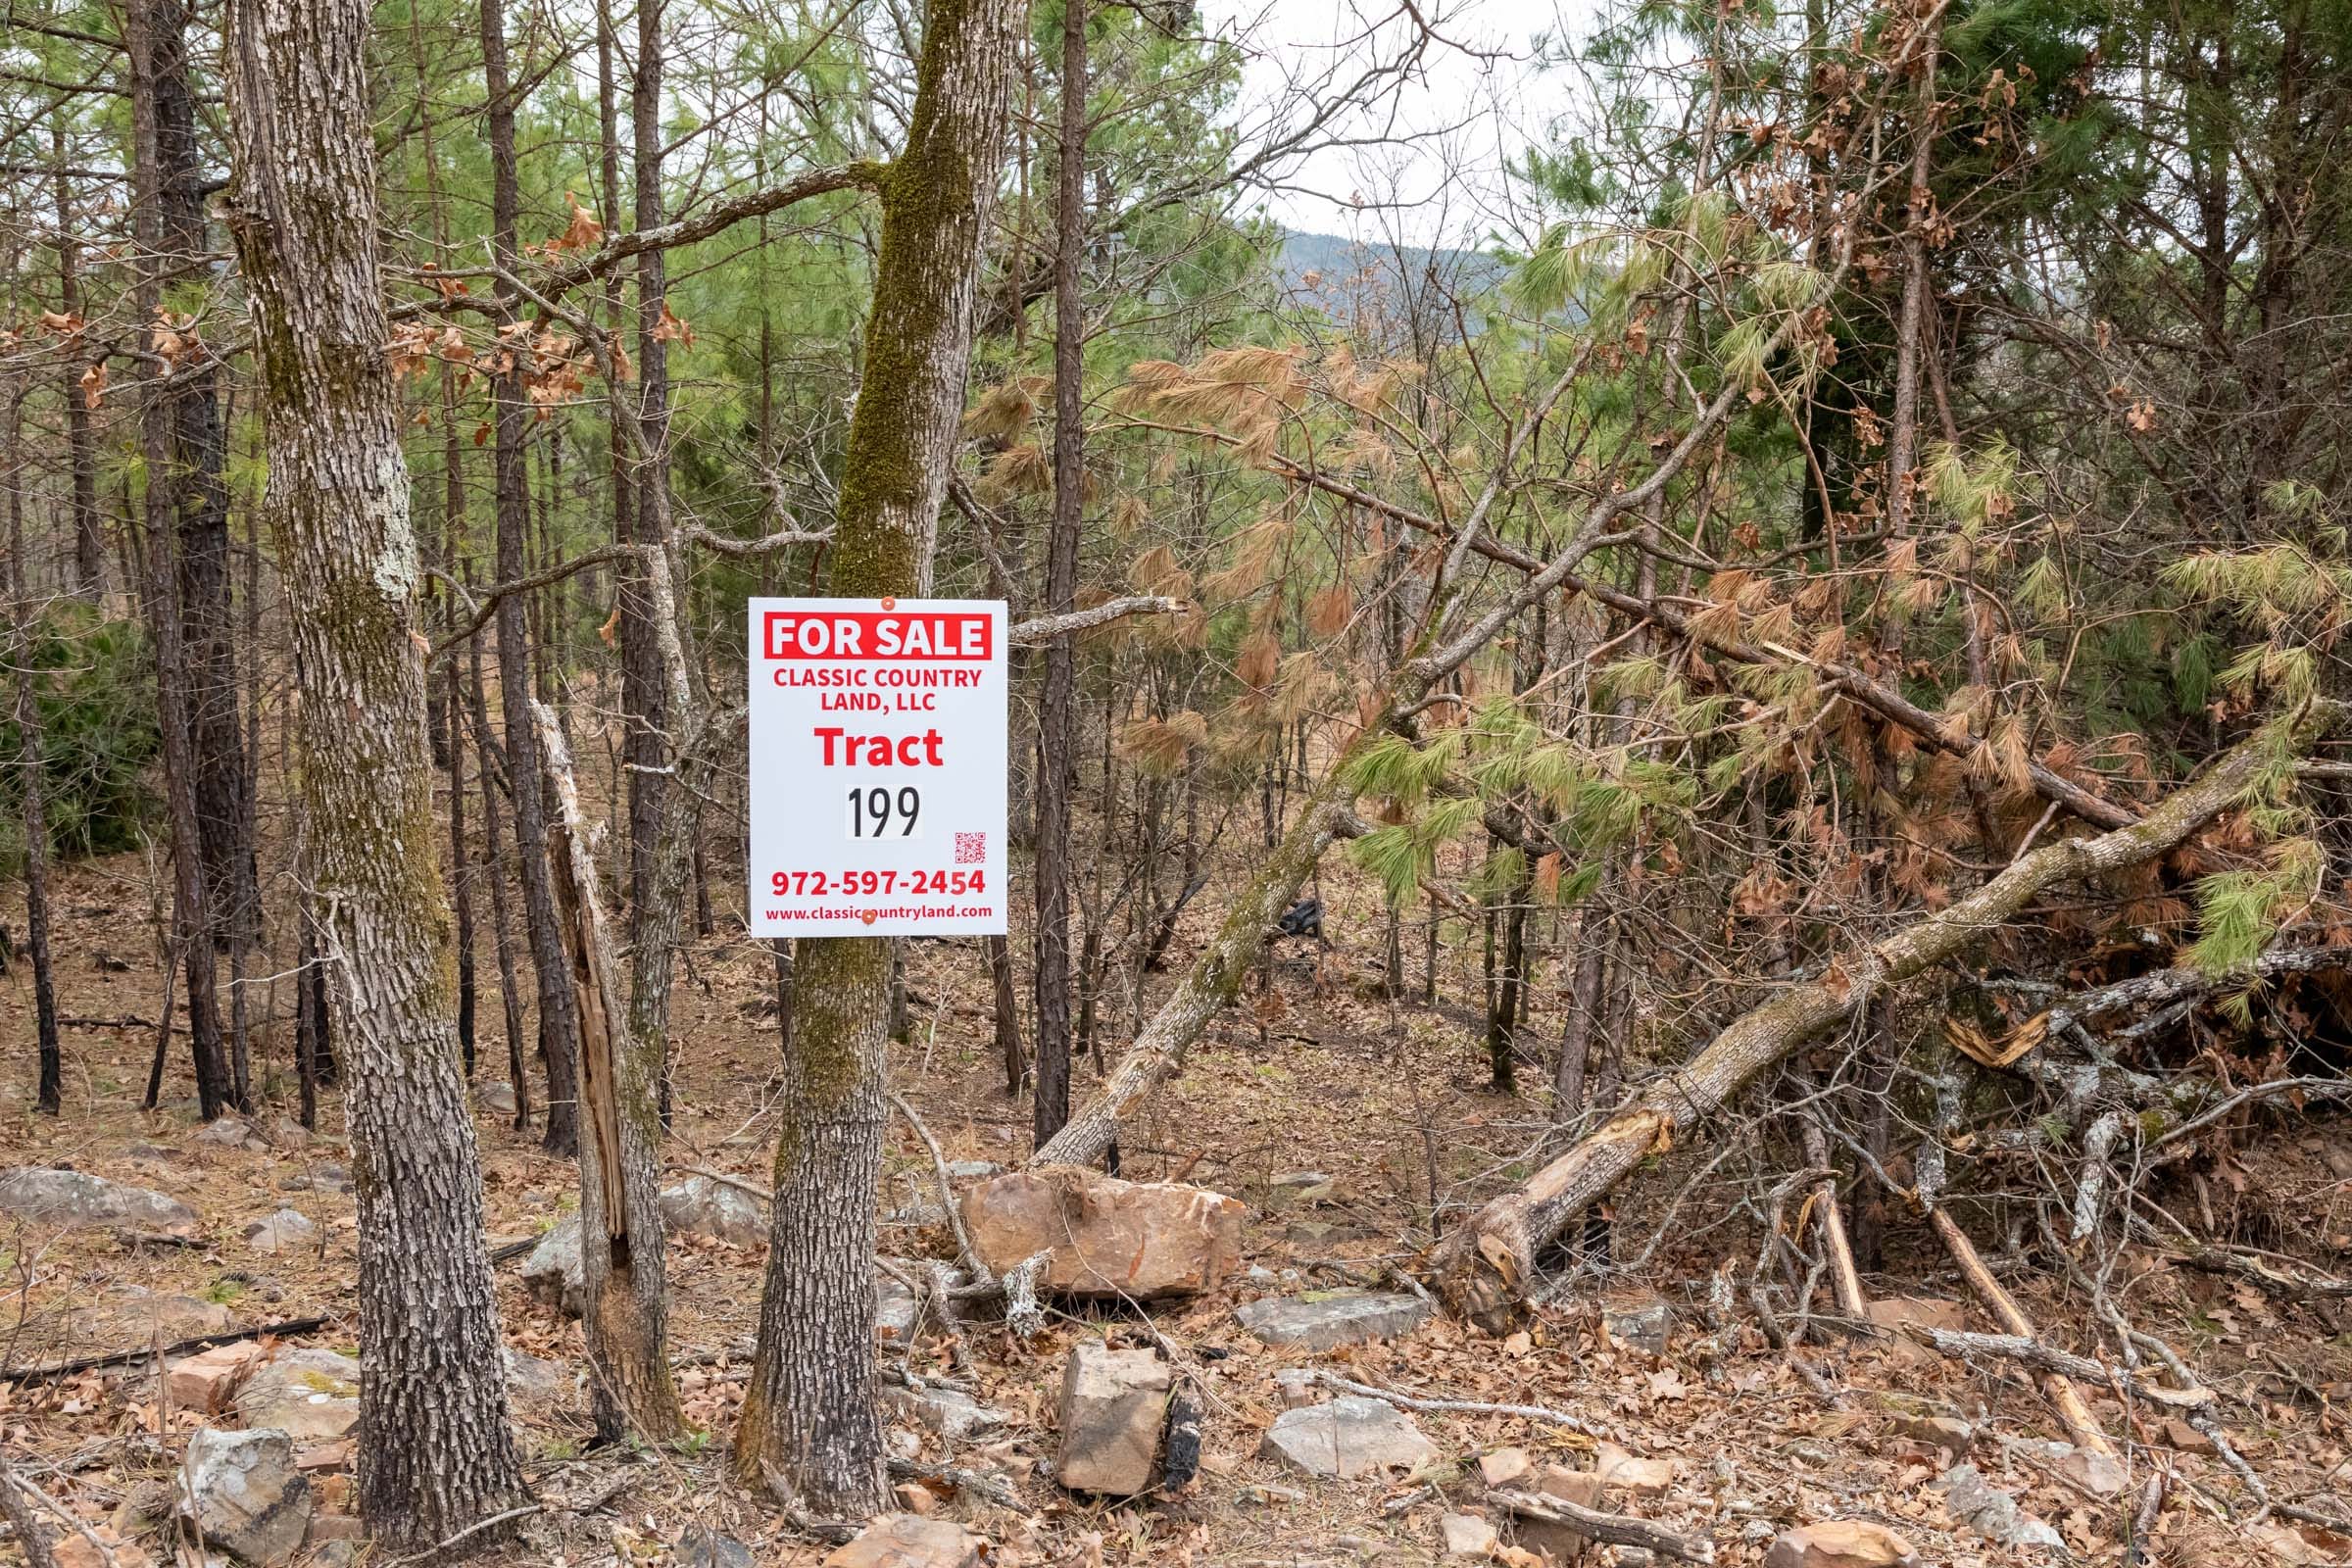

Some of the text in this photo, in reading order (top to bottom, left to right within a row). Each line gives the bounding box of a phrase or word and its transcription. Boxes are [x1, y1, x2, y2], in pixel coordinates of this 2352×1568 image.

[773, 619, 983, 655] FOR SALE
[774, 668, 981, 687] CLASSIC COUNTRY
[822, 693, 935, 714] LAND, LLC
[814, 728, 943, 766] Tract
[850, 787, 919, 837] 199
[772, 870, 985, 895] 972-597-2454
[766, 906, 991, 920] www.classicountryland.com
